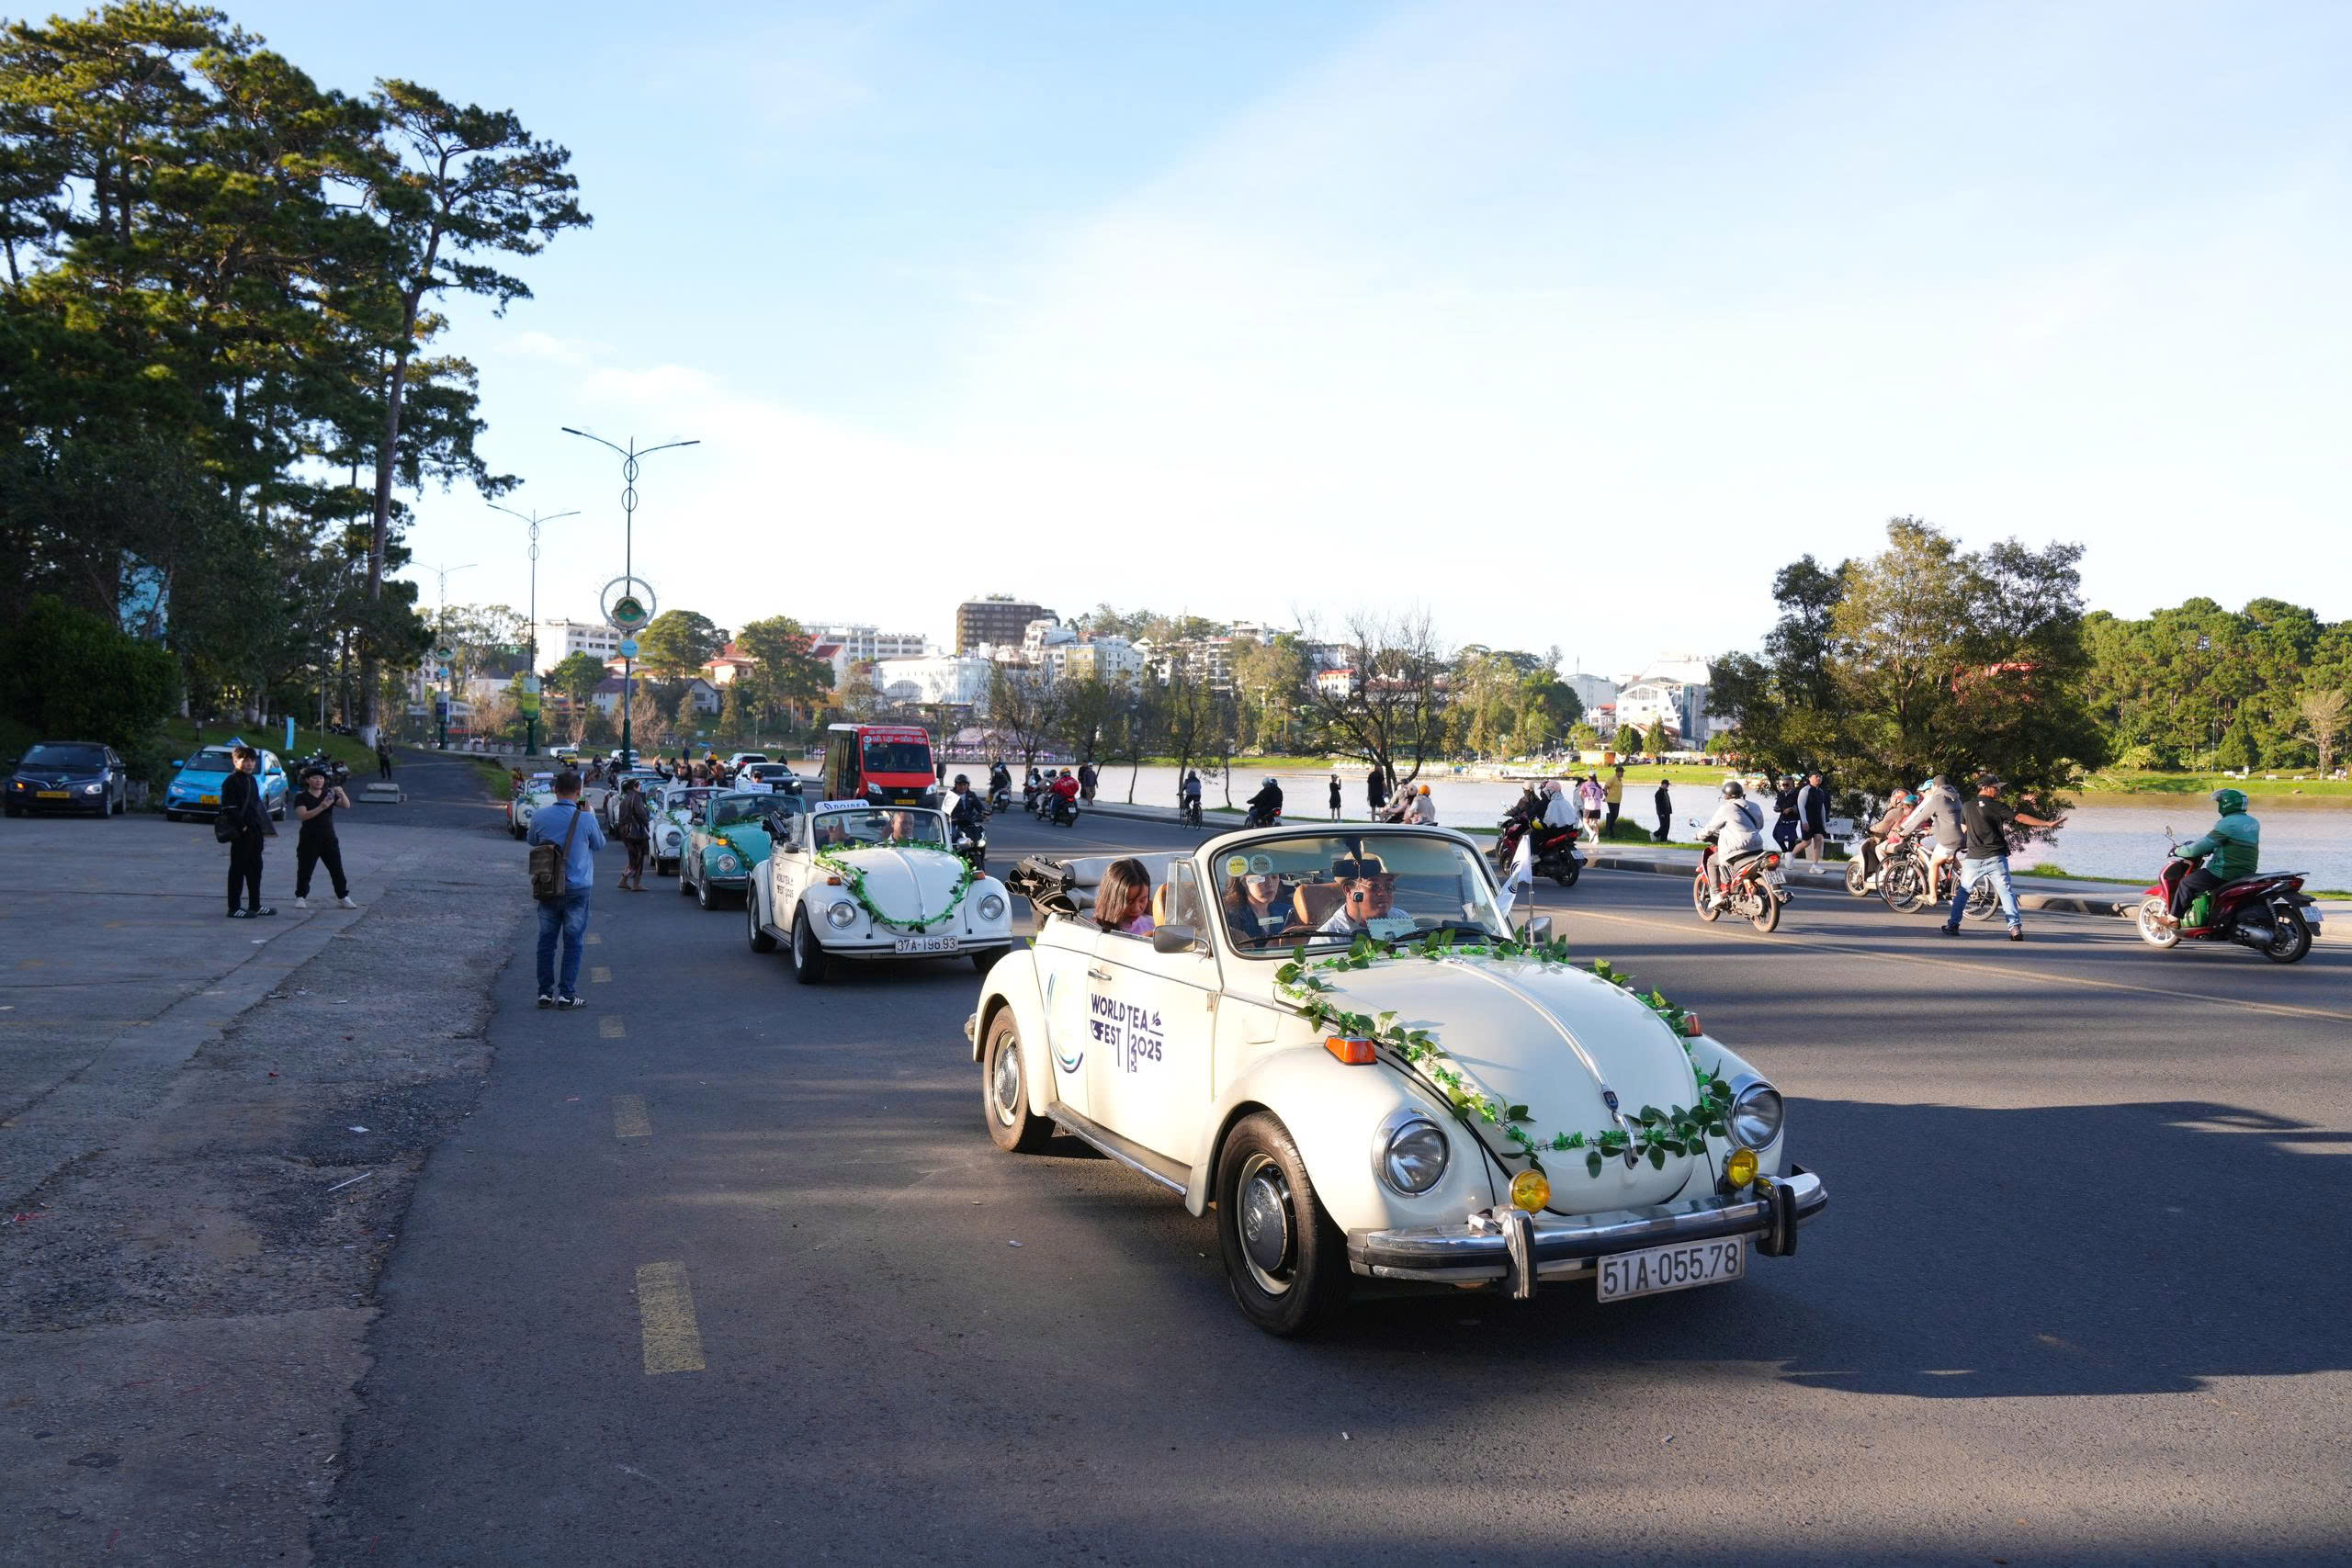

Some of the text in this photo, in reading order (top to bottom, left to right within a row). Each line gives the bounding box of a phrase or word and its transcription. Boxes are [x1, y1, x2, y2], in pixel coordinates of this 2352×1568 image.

[898, 938, 956, 952] 37A-196.93
[1091, 993, 1148, 1051] WORLD TEA
[1091, 1019, 1162, 1062] FEST 2025
[1603, 1242, 1739, 1296] 51A-055.78
